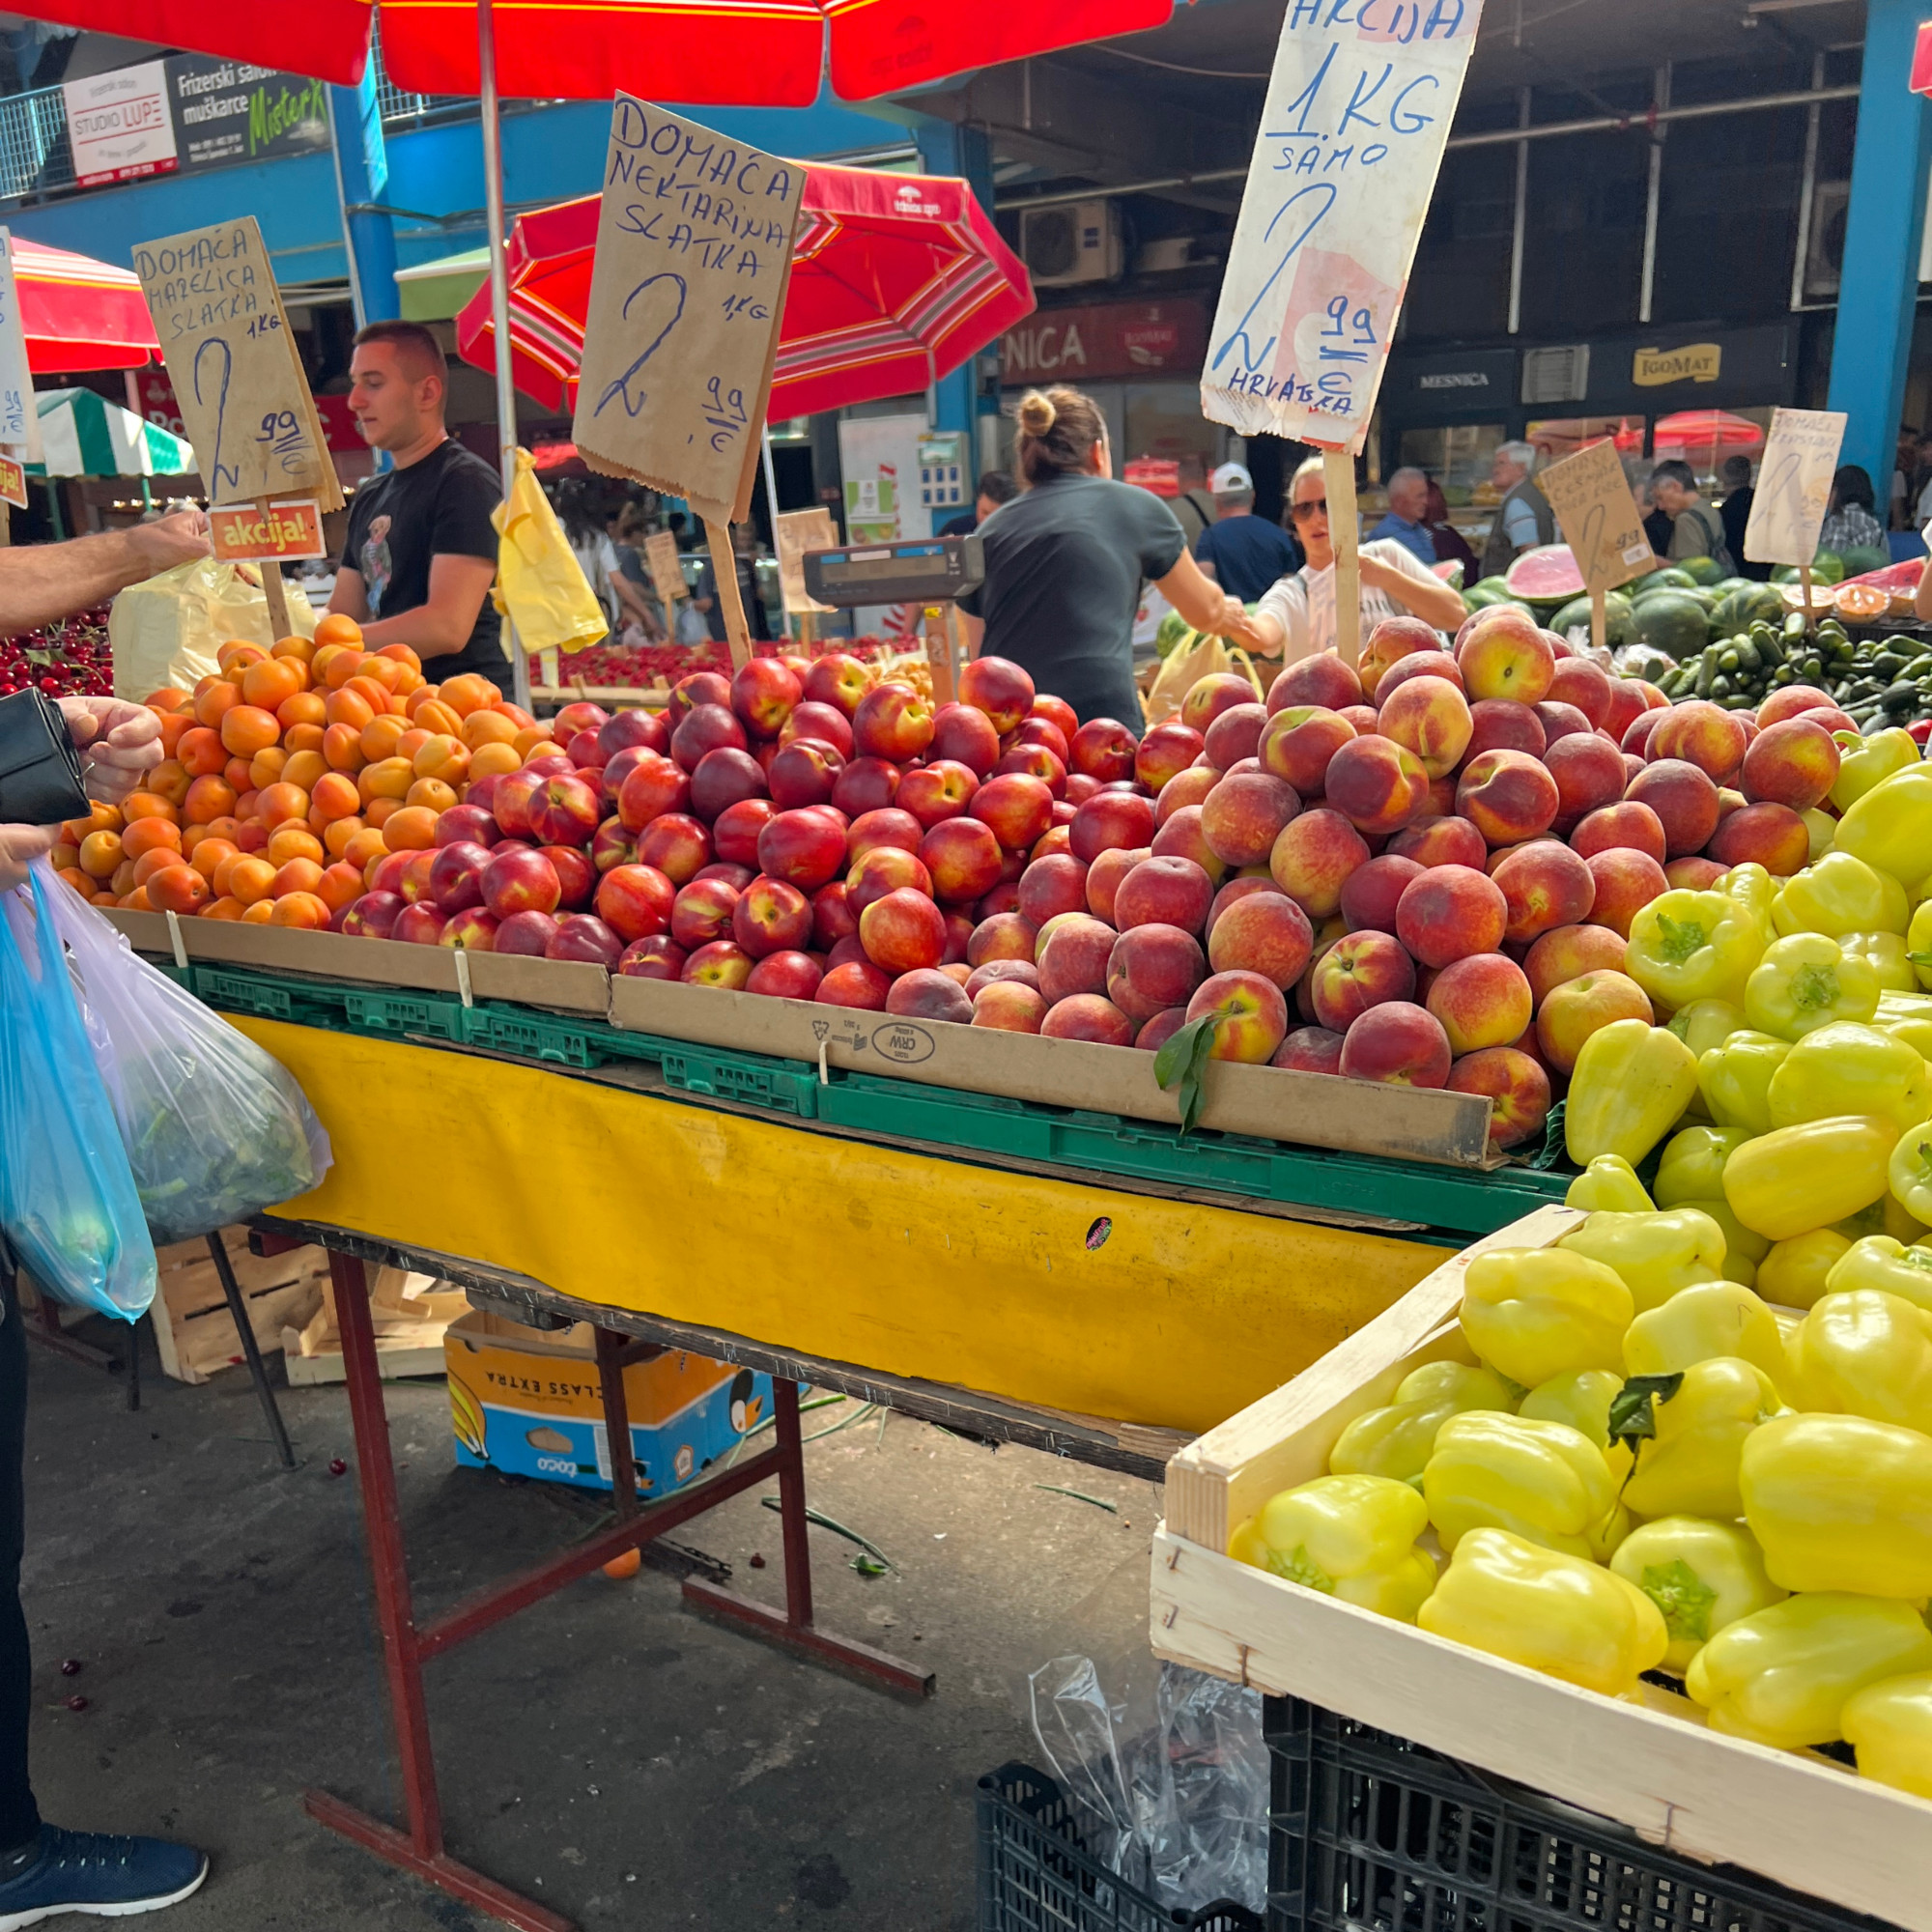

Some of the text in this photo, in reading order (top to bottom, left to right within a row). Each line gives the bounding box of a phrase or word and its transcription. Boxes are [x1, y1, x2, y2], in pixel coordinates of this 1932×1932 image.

[1290, 0, 1464, 44] AKCIJA
[177, 63, 235, 98] Frizerski
[74, 99, 162, 135] STUDIO LUPE
[183, 94, 249, 126] muškarce
[611, 98, 792, 201] DOMAĆA
[1273, 144, 1388, 175] SAMO
[135, 228, 248, 281] DOMAĆA
[170, 292, 258, 340] SLATKA
[1001, 324, 1087, 374] NICA
[223, 515, 307, 553] akcija!
[890, 1036, 916, 1051] CRW
[486, 1372, 541, 1393] EXTRA
[537, 1457, 578, 1478] toco
